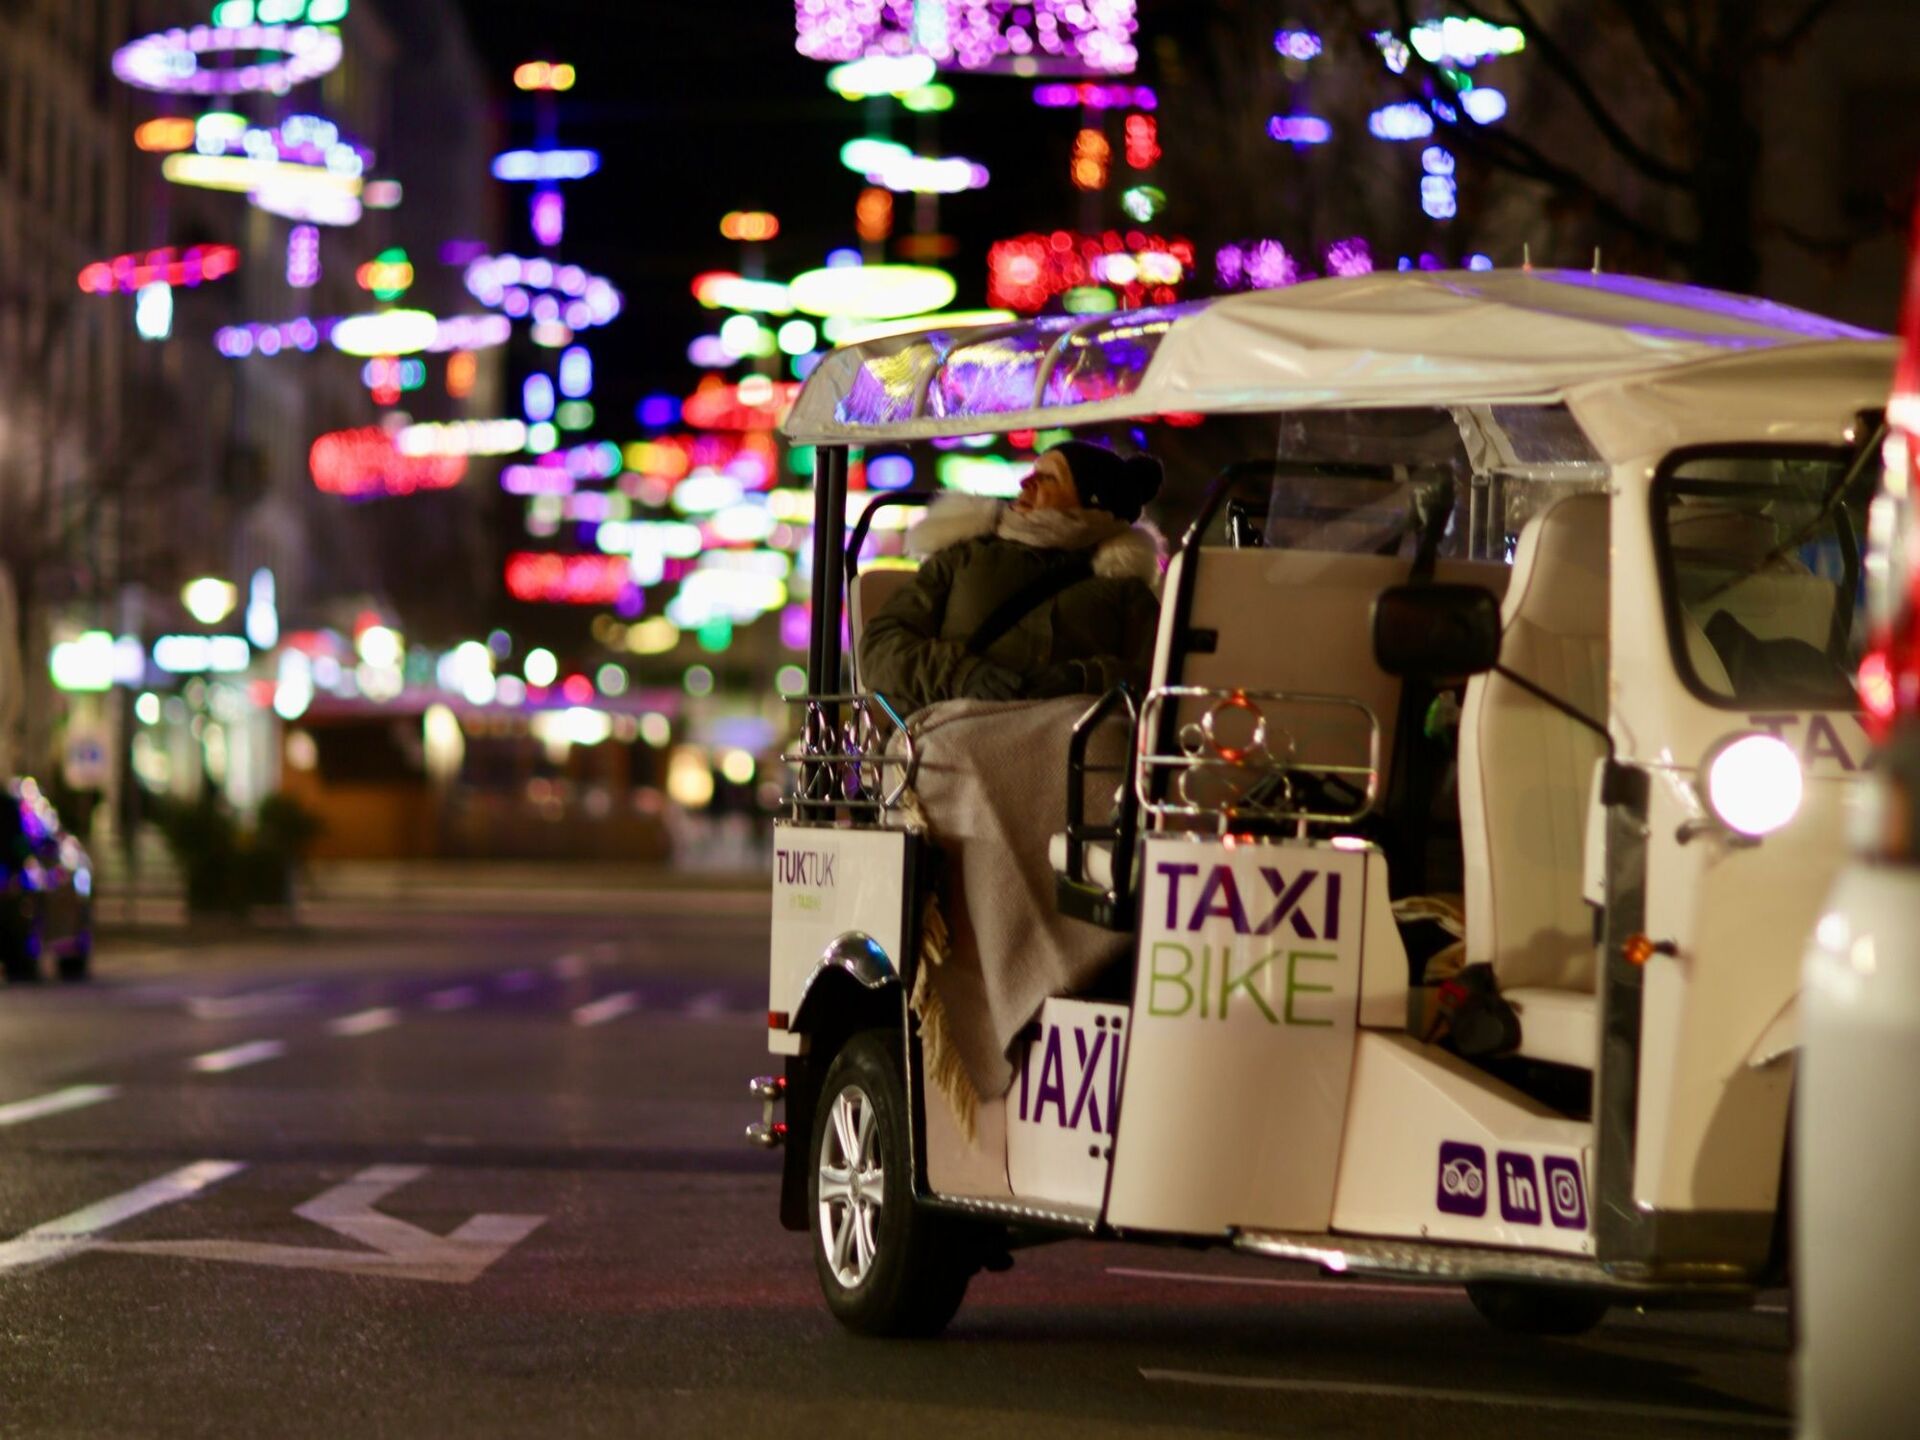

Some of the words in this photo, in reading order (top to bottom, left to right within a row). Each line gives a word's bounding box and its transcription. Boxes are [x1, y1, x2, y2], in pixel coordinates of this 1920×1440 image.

[776, 850, 835, 888] TUKTUK
[1157, 863, 1342, 941] TAXI
[1148, 942, 1338, 1027] BIKE
[1504, 1161, 1537, 1212] in
